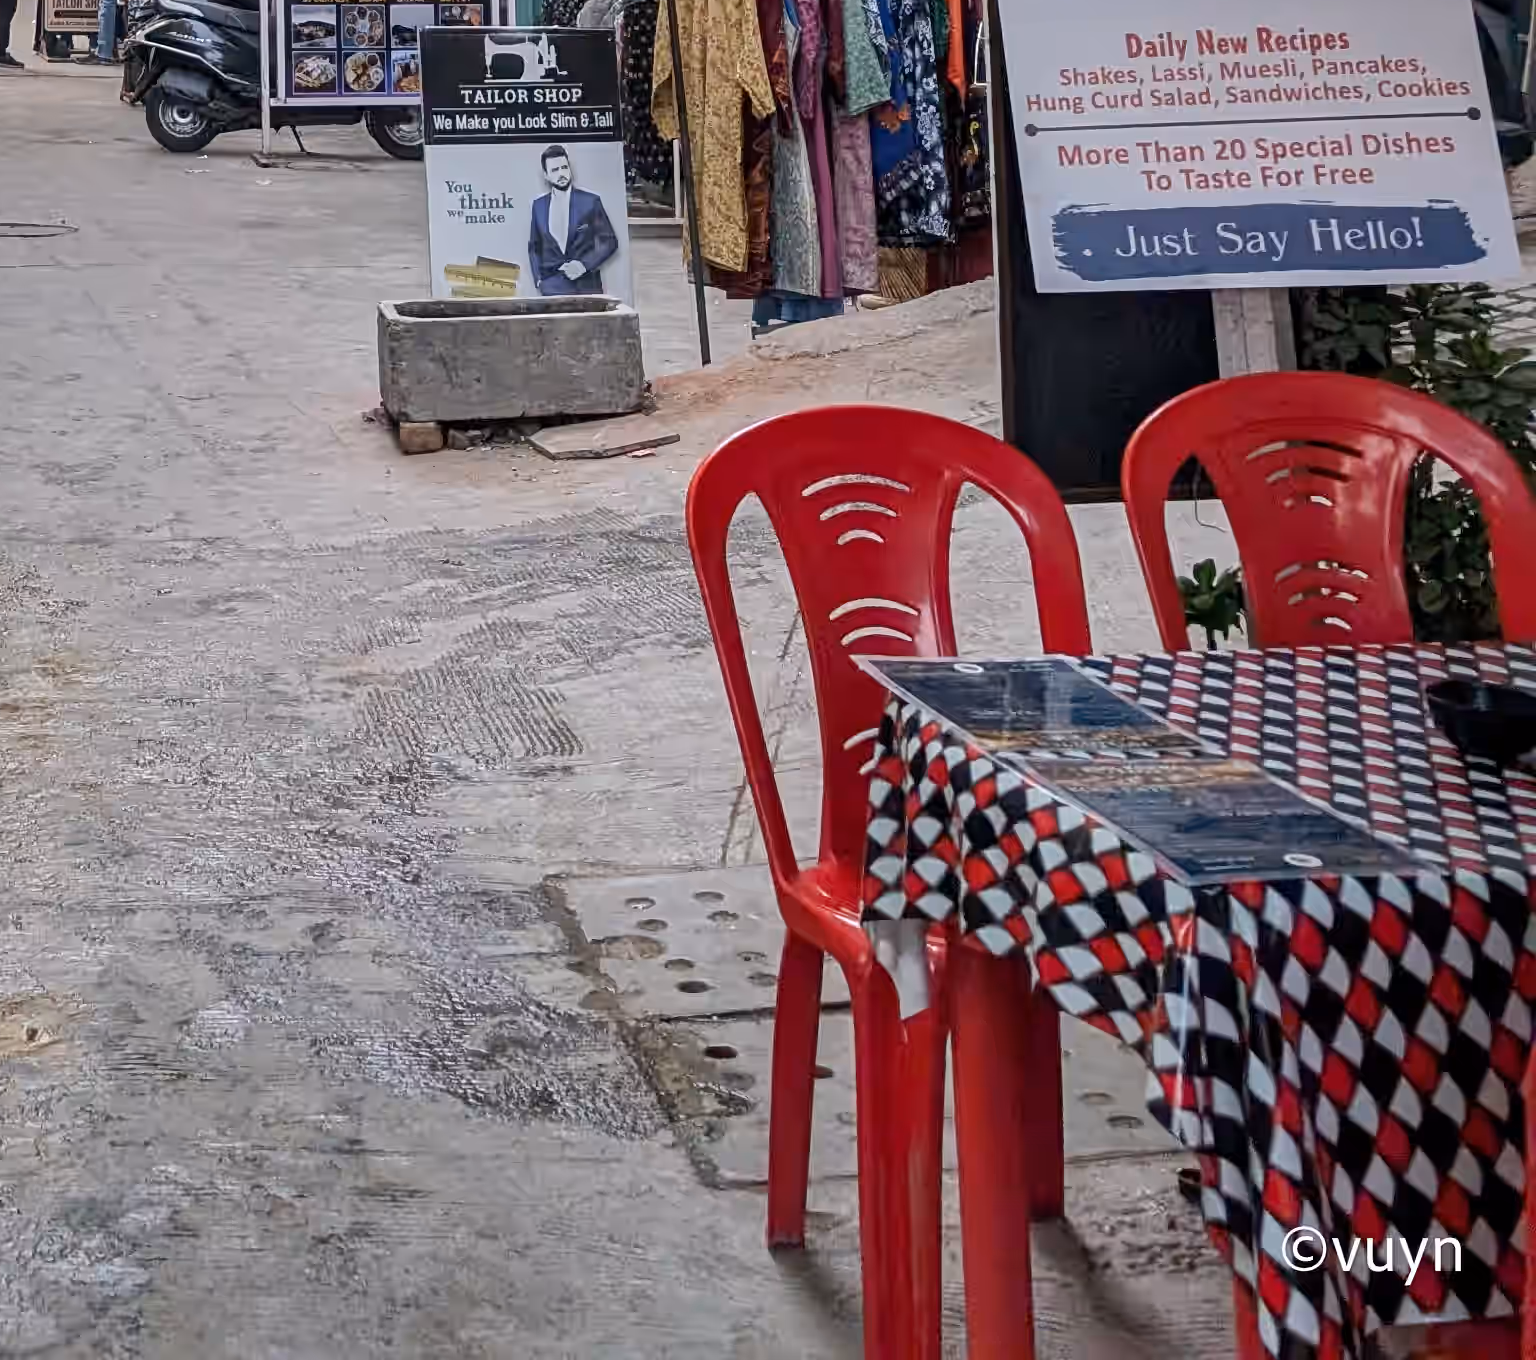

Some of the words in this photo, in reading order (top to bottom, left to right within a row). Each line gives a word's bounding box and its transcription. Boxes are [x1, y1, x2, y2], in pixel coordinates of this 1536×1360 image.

[1125, 32, 1189, 61] Daily
[1196, 29, 1248, 56] New
[1255, 27, 1351, 57] Recipes
[1058, 64, 1145, 89] Shakes,
[1150, 62, 1213, 85] Lassi,
[1219, 57, 1306, 82] Muesli,
[1311, 53, 1429, 78] Pancakes,
[461, 88, 528, 105] TAILOR
[534, 87, 583, 104] SHOP
[1025, 92, 1085, 115] Hung
[1090, 88, 1147, 111] Curd
[1150, 85, 1221, 109] Salad,
[1225, 80, 1373, 105] Sandwiches,
[1377, 77, 1471, 100] Cookies
[433, 113, 452, 130] We
[456, 113, 490, 130] Make
[493, 115, 515, 133] you
[517, 112, 547, 129] Look
[550, 112, 577, 128] Slim
[580, 112, 589, 128] &
[593, 111, 614, 127] Tall
[1056, 142, 1130, 168] More
[1136, 140, 1209, 164] Than
[1214, 138, 1247, 162] 20
[1255, 134, 1353, 165] Special
[1362, 131, 1456, 158] Dishes
[445, 180, 472, 195] You
[1144, 169, 1173, 191] To
[1178, 167, 1253, 190] Taste
[1260, 166, 1305, 188] For
[1310, 164, 1374, 185] Free
[446, 208, 463, 218] we
[458, 192, 514, 211] think
[464, 210, 505, 225] make
[1115, 223, 1199, 259] Just
[1215, 222, 1289, 260] Say
[1308, 216, 1425, 254] Hello!
